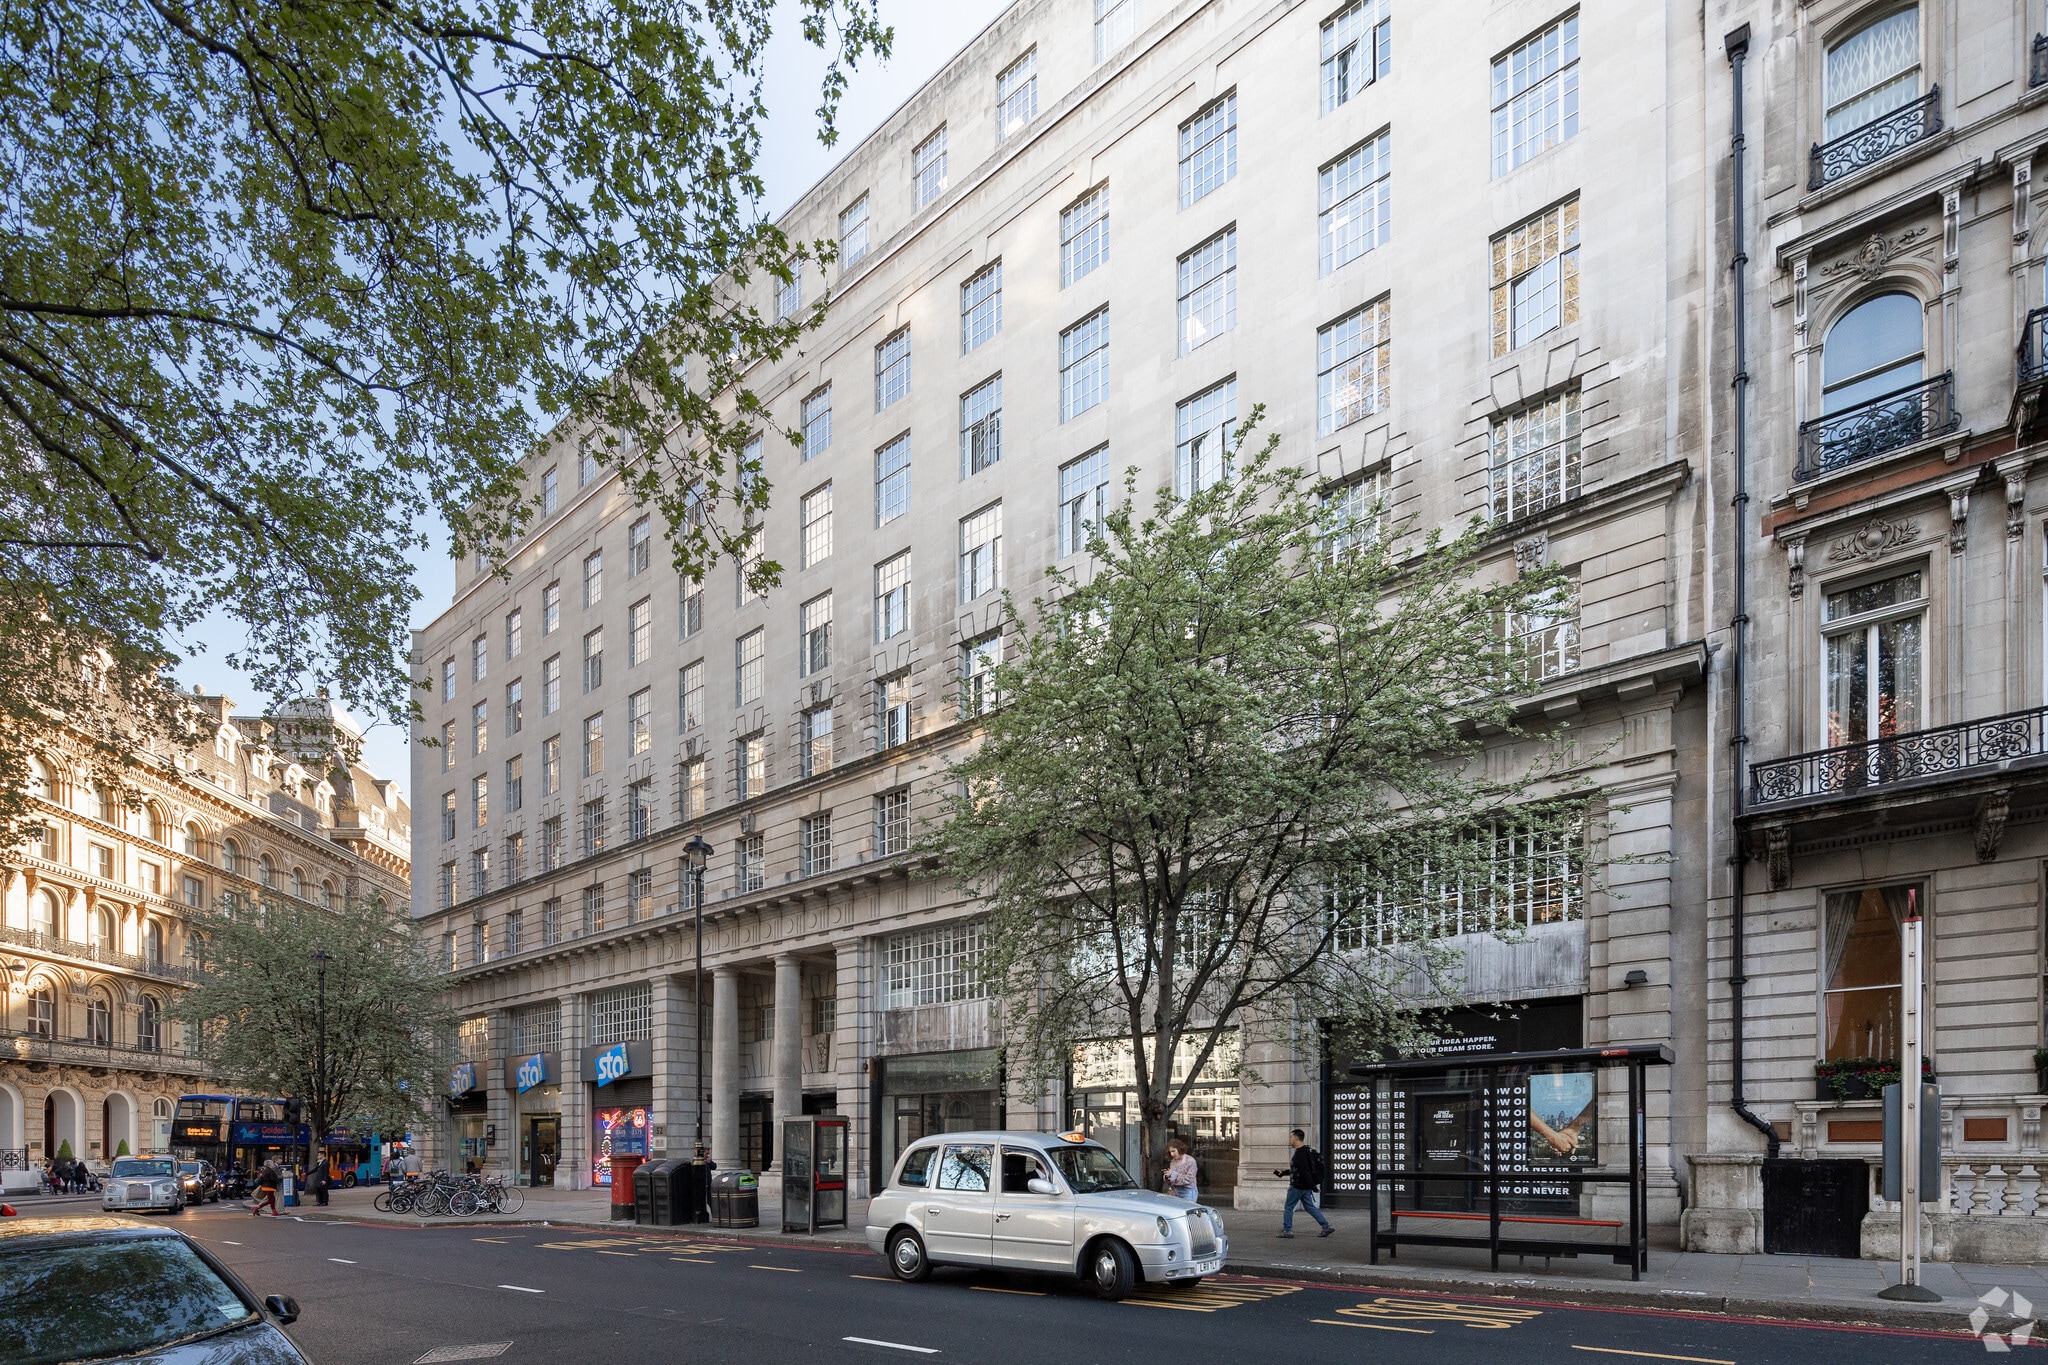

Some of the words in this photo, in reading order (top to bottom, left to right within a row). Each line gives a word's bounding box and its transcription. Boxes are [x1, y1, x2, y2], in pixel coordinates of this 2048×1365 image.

[519, 1062, 539, 1088] sta
[598, 1051, 624, 1080] sta
[262, 1126, 284, 1134] Golden
[1336, 1297, 1543, 1329] BUS
